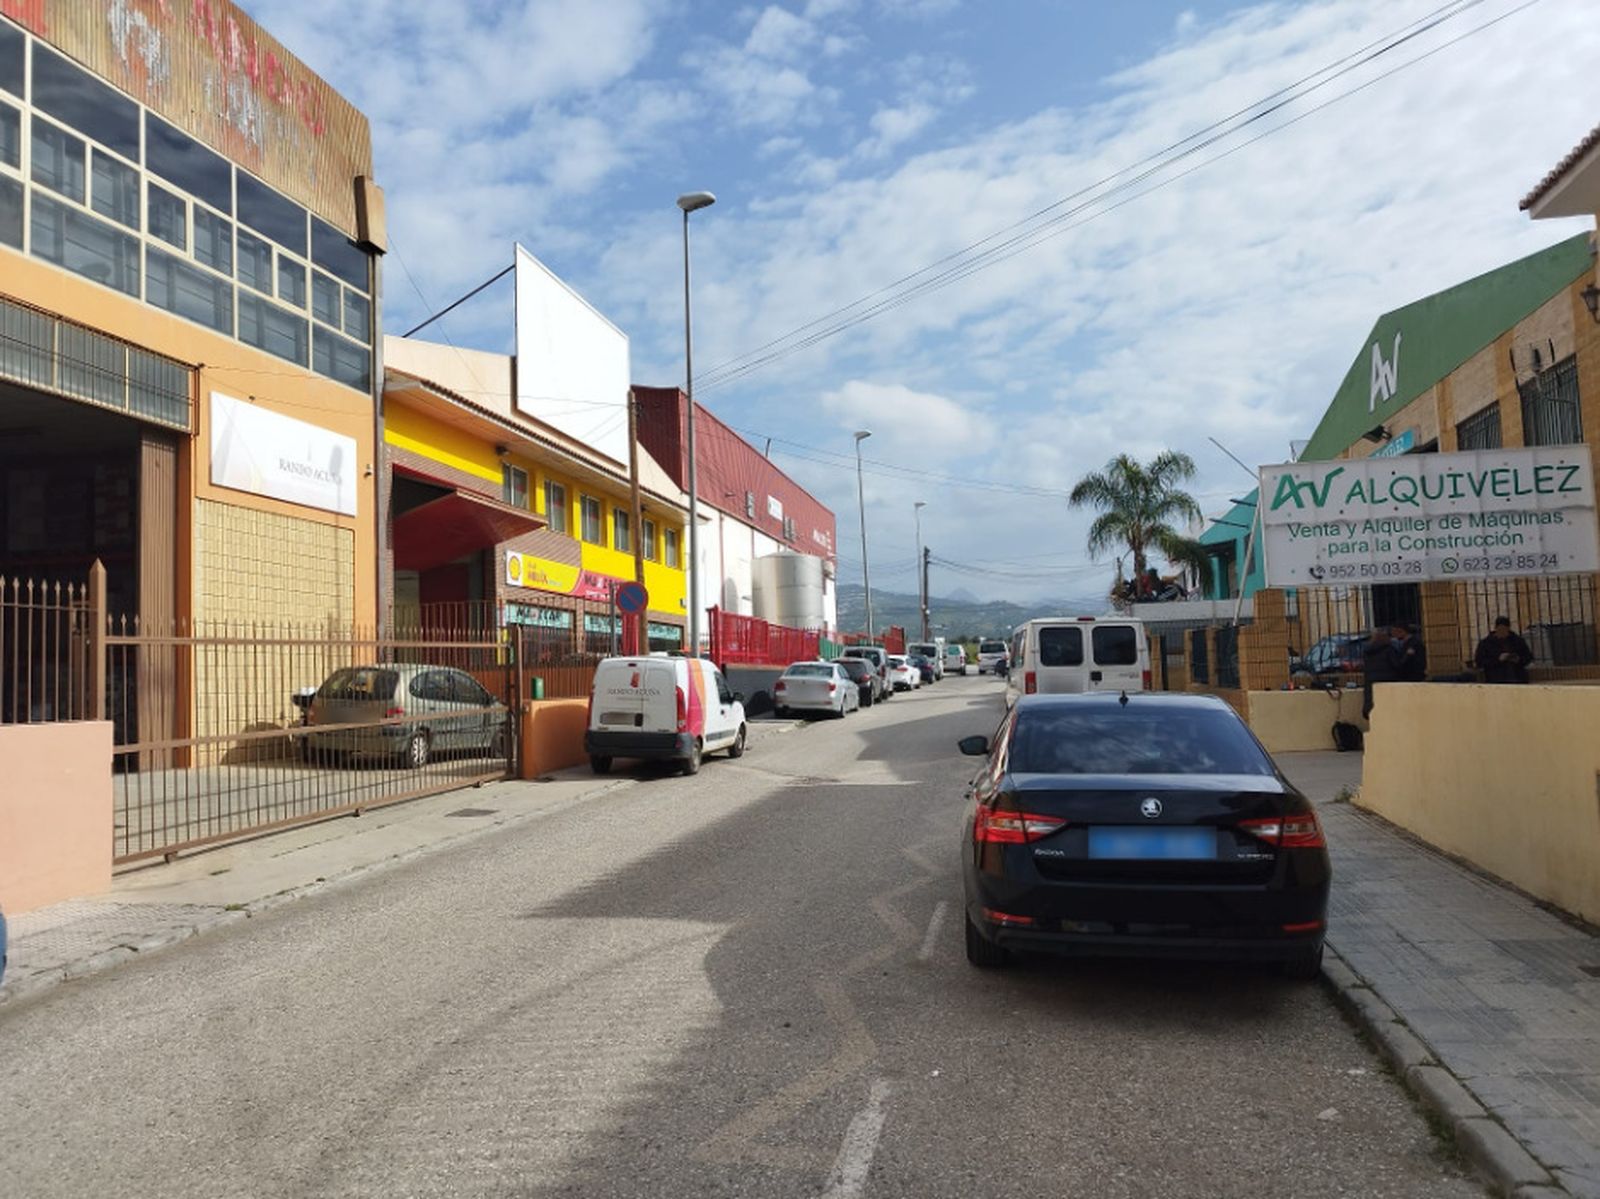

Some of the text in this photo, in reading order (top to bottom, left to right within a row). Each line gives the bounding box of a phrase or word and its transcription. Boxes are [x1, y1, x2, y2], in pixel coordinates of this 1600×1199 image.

[1345, 465, 1582, 507] ALQUIVELEZ
[1287, 510, 1564, 539] Venta y Alquiler de Máquinas
[1327, 530, 1524, 557] para la Construcción
[1329, 565, 1355, 578] 952
[1360, 564, 1379, 577] 50
[1382, 562, 1401, 576] 03
[1463, 553, 1558, 572] 623 29 85 24
